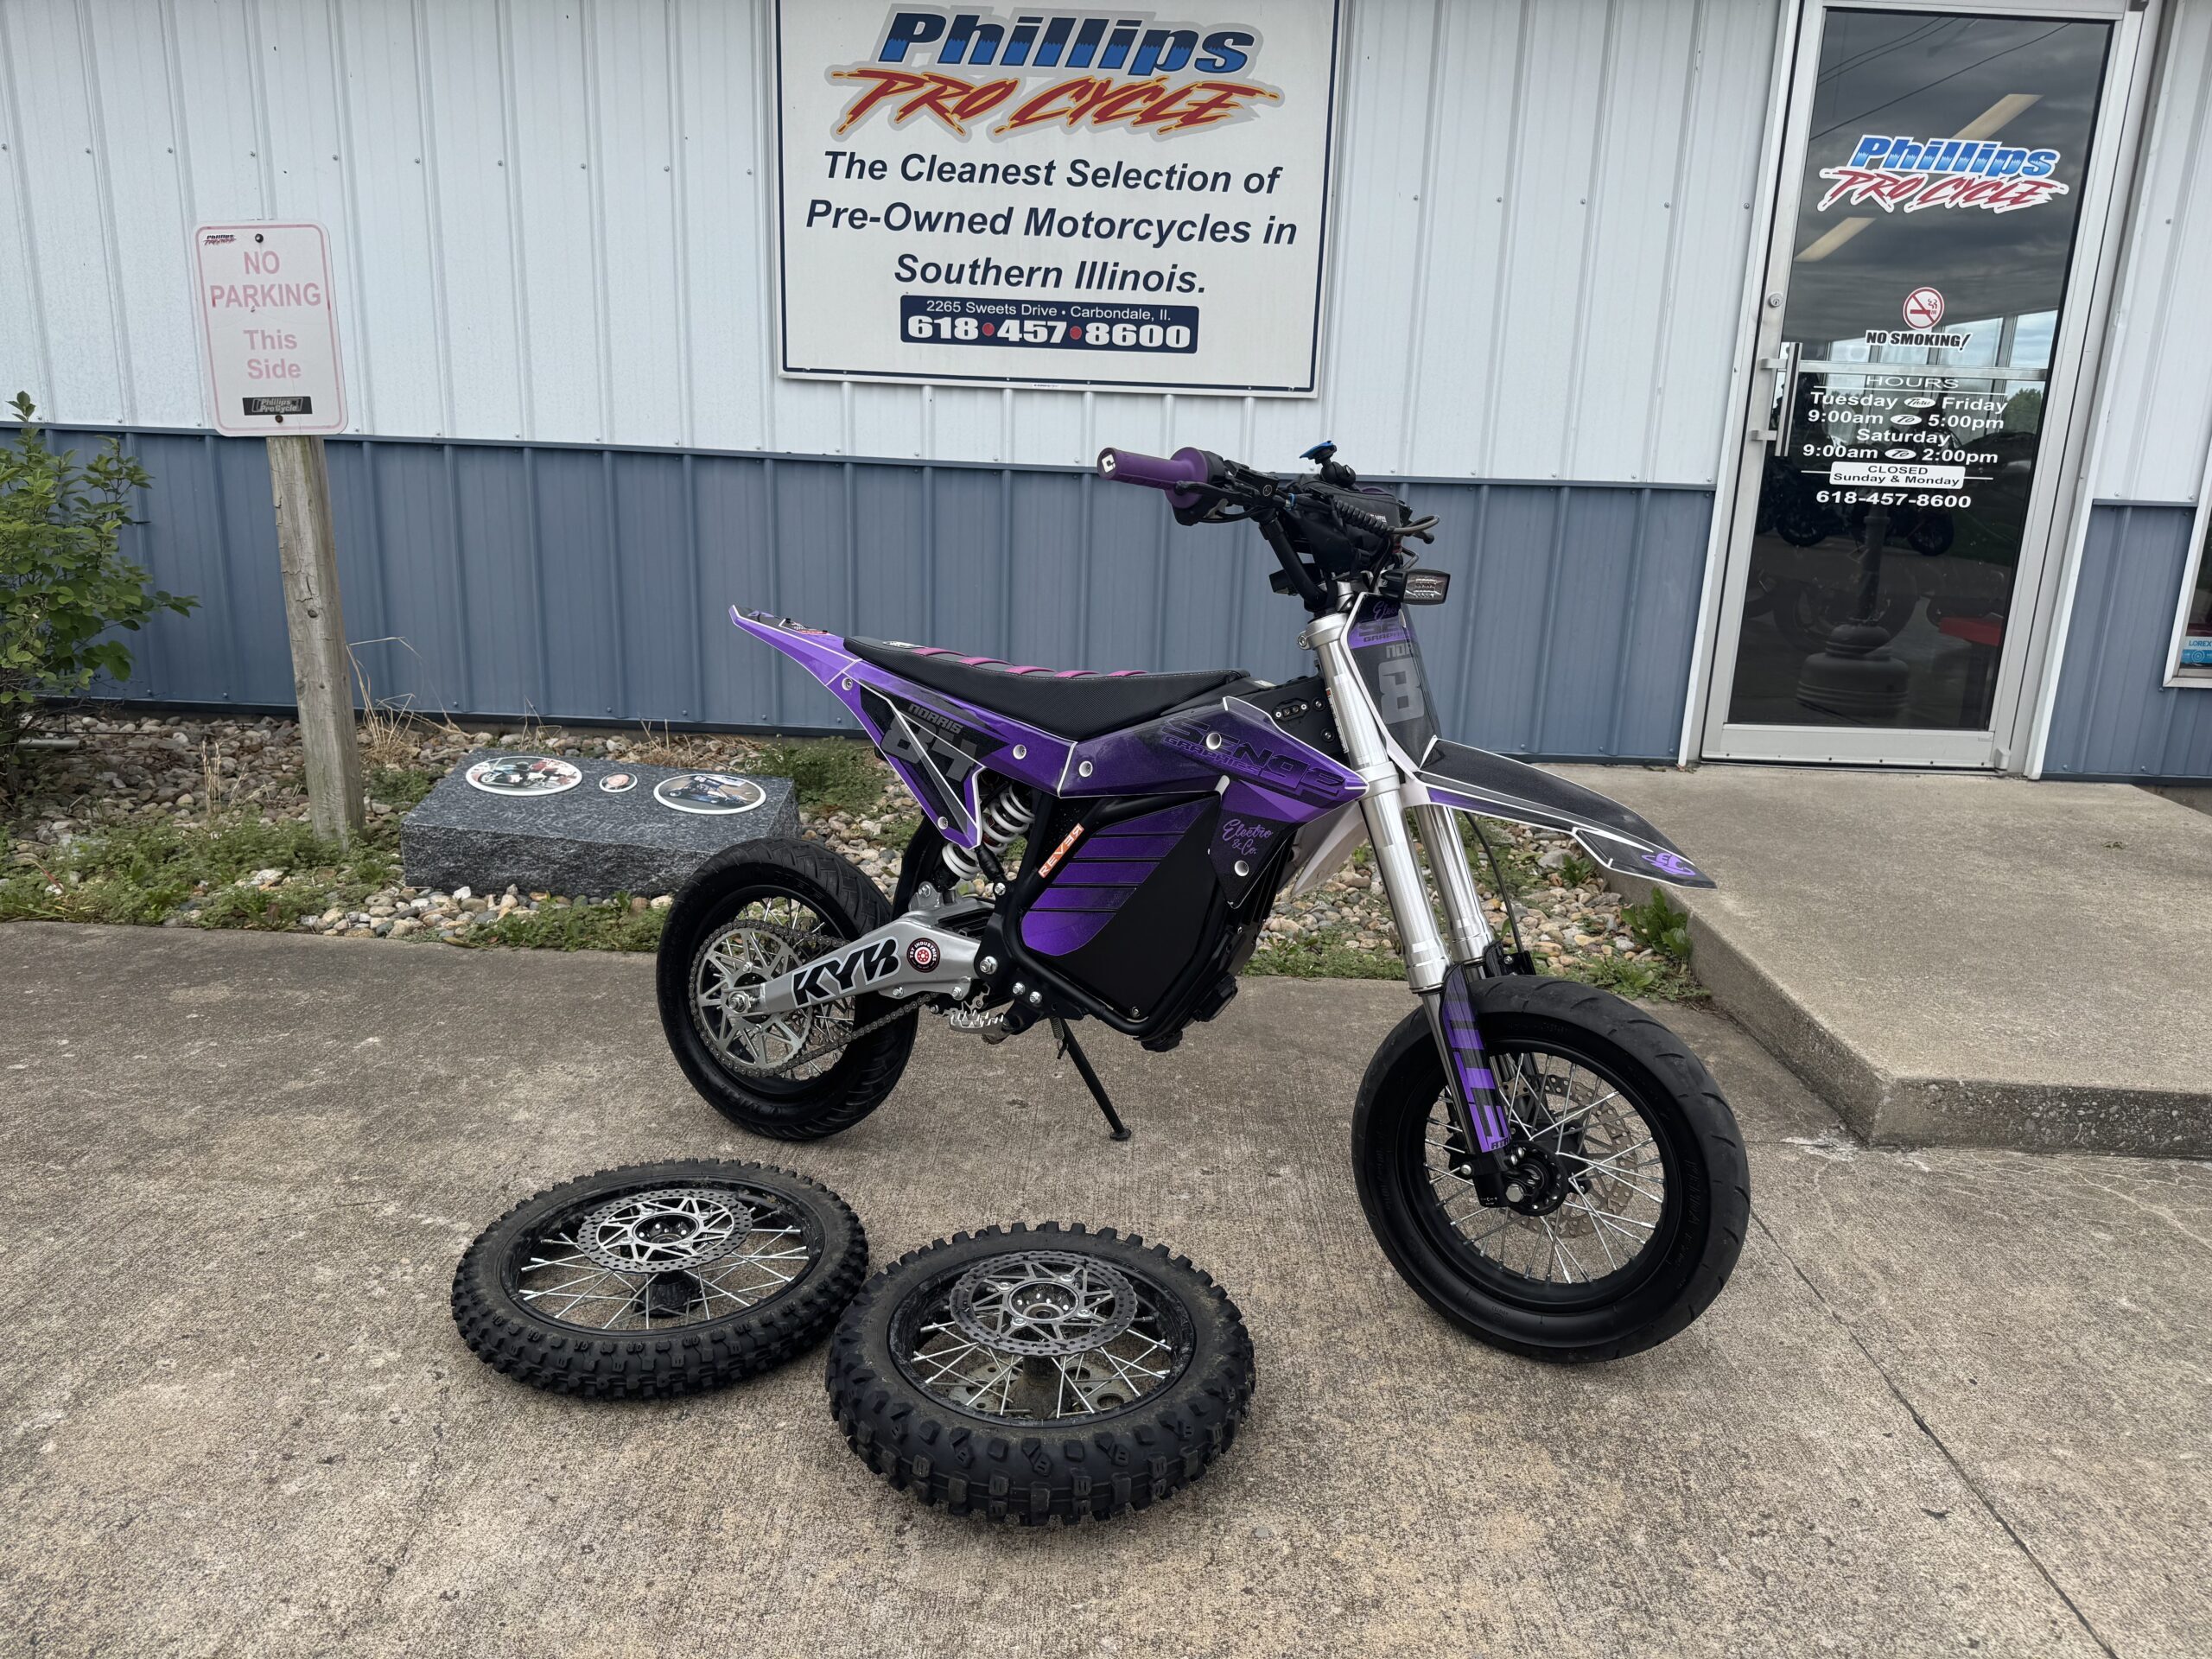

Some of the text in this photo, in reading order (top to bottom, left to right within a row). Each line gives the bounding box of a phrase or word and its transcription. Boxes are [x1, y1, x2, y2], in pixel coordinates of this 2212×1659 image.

[877, 12, 1255, 76] Phillips
[831, 68, 1281, 136] PRO CYCLE
[1849, 136, 2059, 178] Phillips
[823, 151, 1283, 194] The Cleanest Selection of
[1818, 170, 2068, 213] PRO CYCLE
[806, 200, 1298, 248] Pre-Owned Motorcycles in
[244, 251, 280, 275] NO
[894, 254, 1206, 294] Southern Illinois.
[210, 283, 321, 308] PARKING
[926, 301, 962, 314] 2265
[965, 302, 1017, 316] Sweets
[1021, 304, 1058, 317] Drive
[1070, 306, 1155, 322] Carbondale,
[243, 329, 298, 350] This
[1866, 332, 1971, 351] NO SMOKING!
[247, 359, 302, 380] Side
[1866, 377, 1959, 389] HOURS
[1810, 391, 1897, 410] Tuesday
[1942, 397, 2007, 412] Friday
[1808, 410, 1884, 424] 9:00am
[1928, 414, 2004, 429] 5:00pm
[1857, 429, 1951, 447] Saturday
[1802, 445, 1878, 459] 9:00am
[1922, 448, 1998, 464] 2:00pm
[1834, 473, 1885, 484] Sunday
[1904, 476, 1960, 486] Monday
[1867, 466, 1928, 474] CLOSED
[1816, 490, 1971, 508] 618-457-8600
[908, 703, 963, 735] NORRIS
[1163, 736, 1262, 777] GRAPHICS
[1222, 819, 1273, 842] Electro
[793, 937, 901, 1007] KYB
